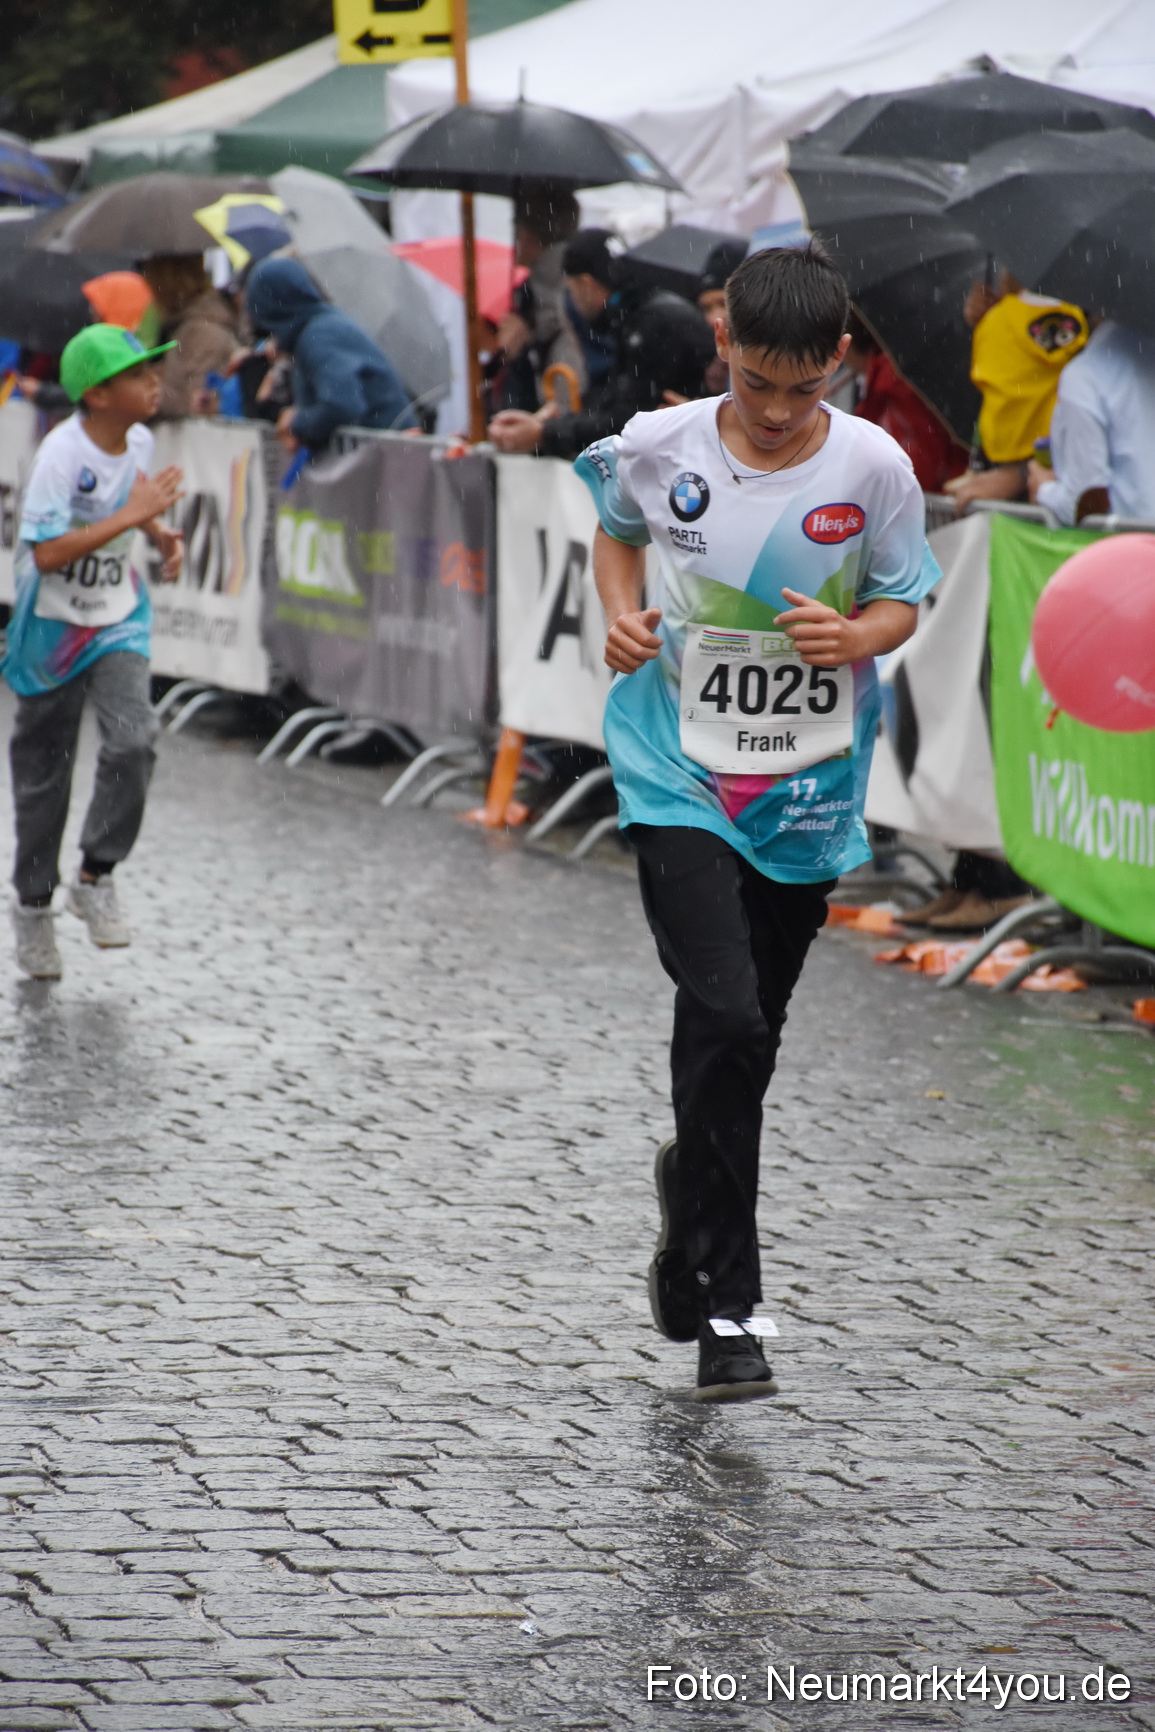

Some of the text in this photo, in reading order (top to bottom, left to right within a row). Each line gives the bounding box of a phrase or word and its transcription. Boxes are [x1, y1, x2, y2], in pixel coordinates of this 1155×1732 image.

[673, 474, 708, 491] BMW
[812, 514, 859, 533] Hervis
[668, 526, 707, 545] PARTL
[698, 642, 751, 654] NeuerMarkt
[700, 663, 839, 715] 4025
[737, 731, 797, 752] Frank
[788, 778, 822, 801] 17.
